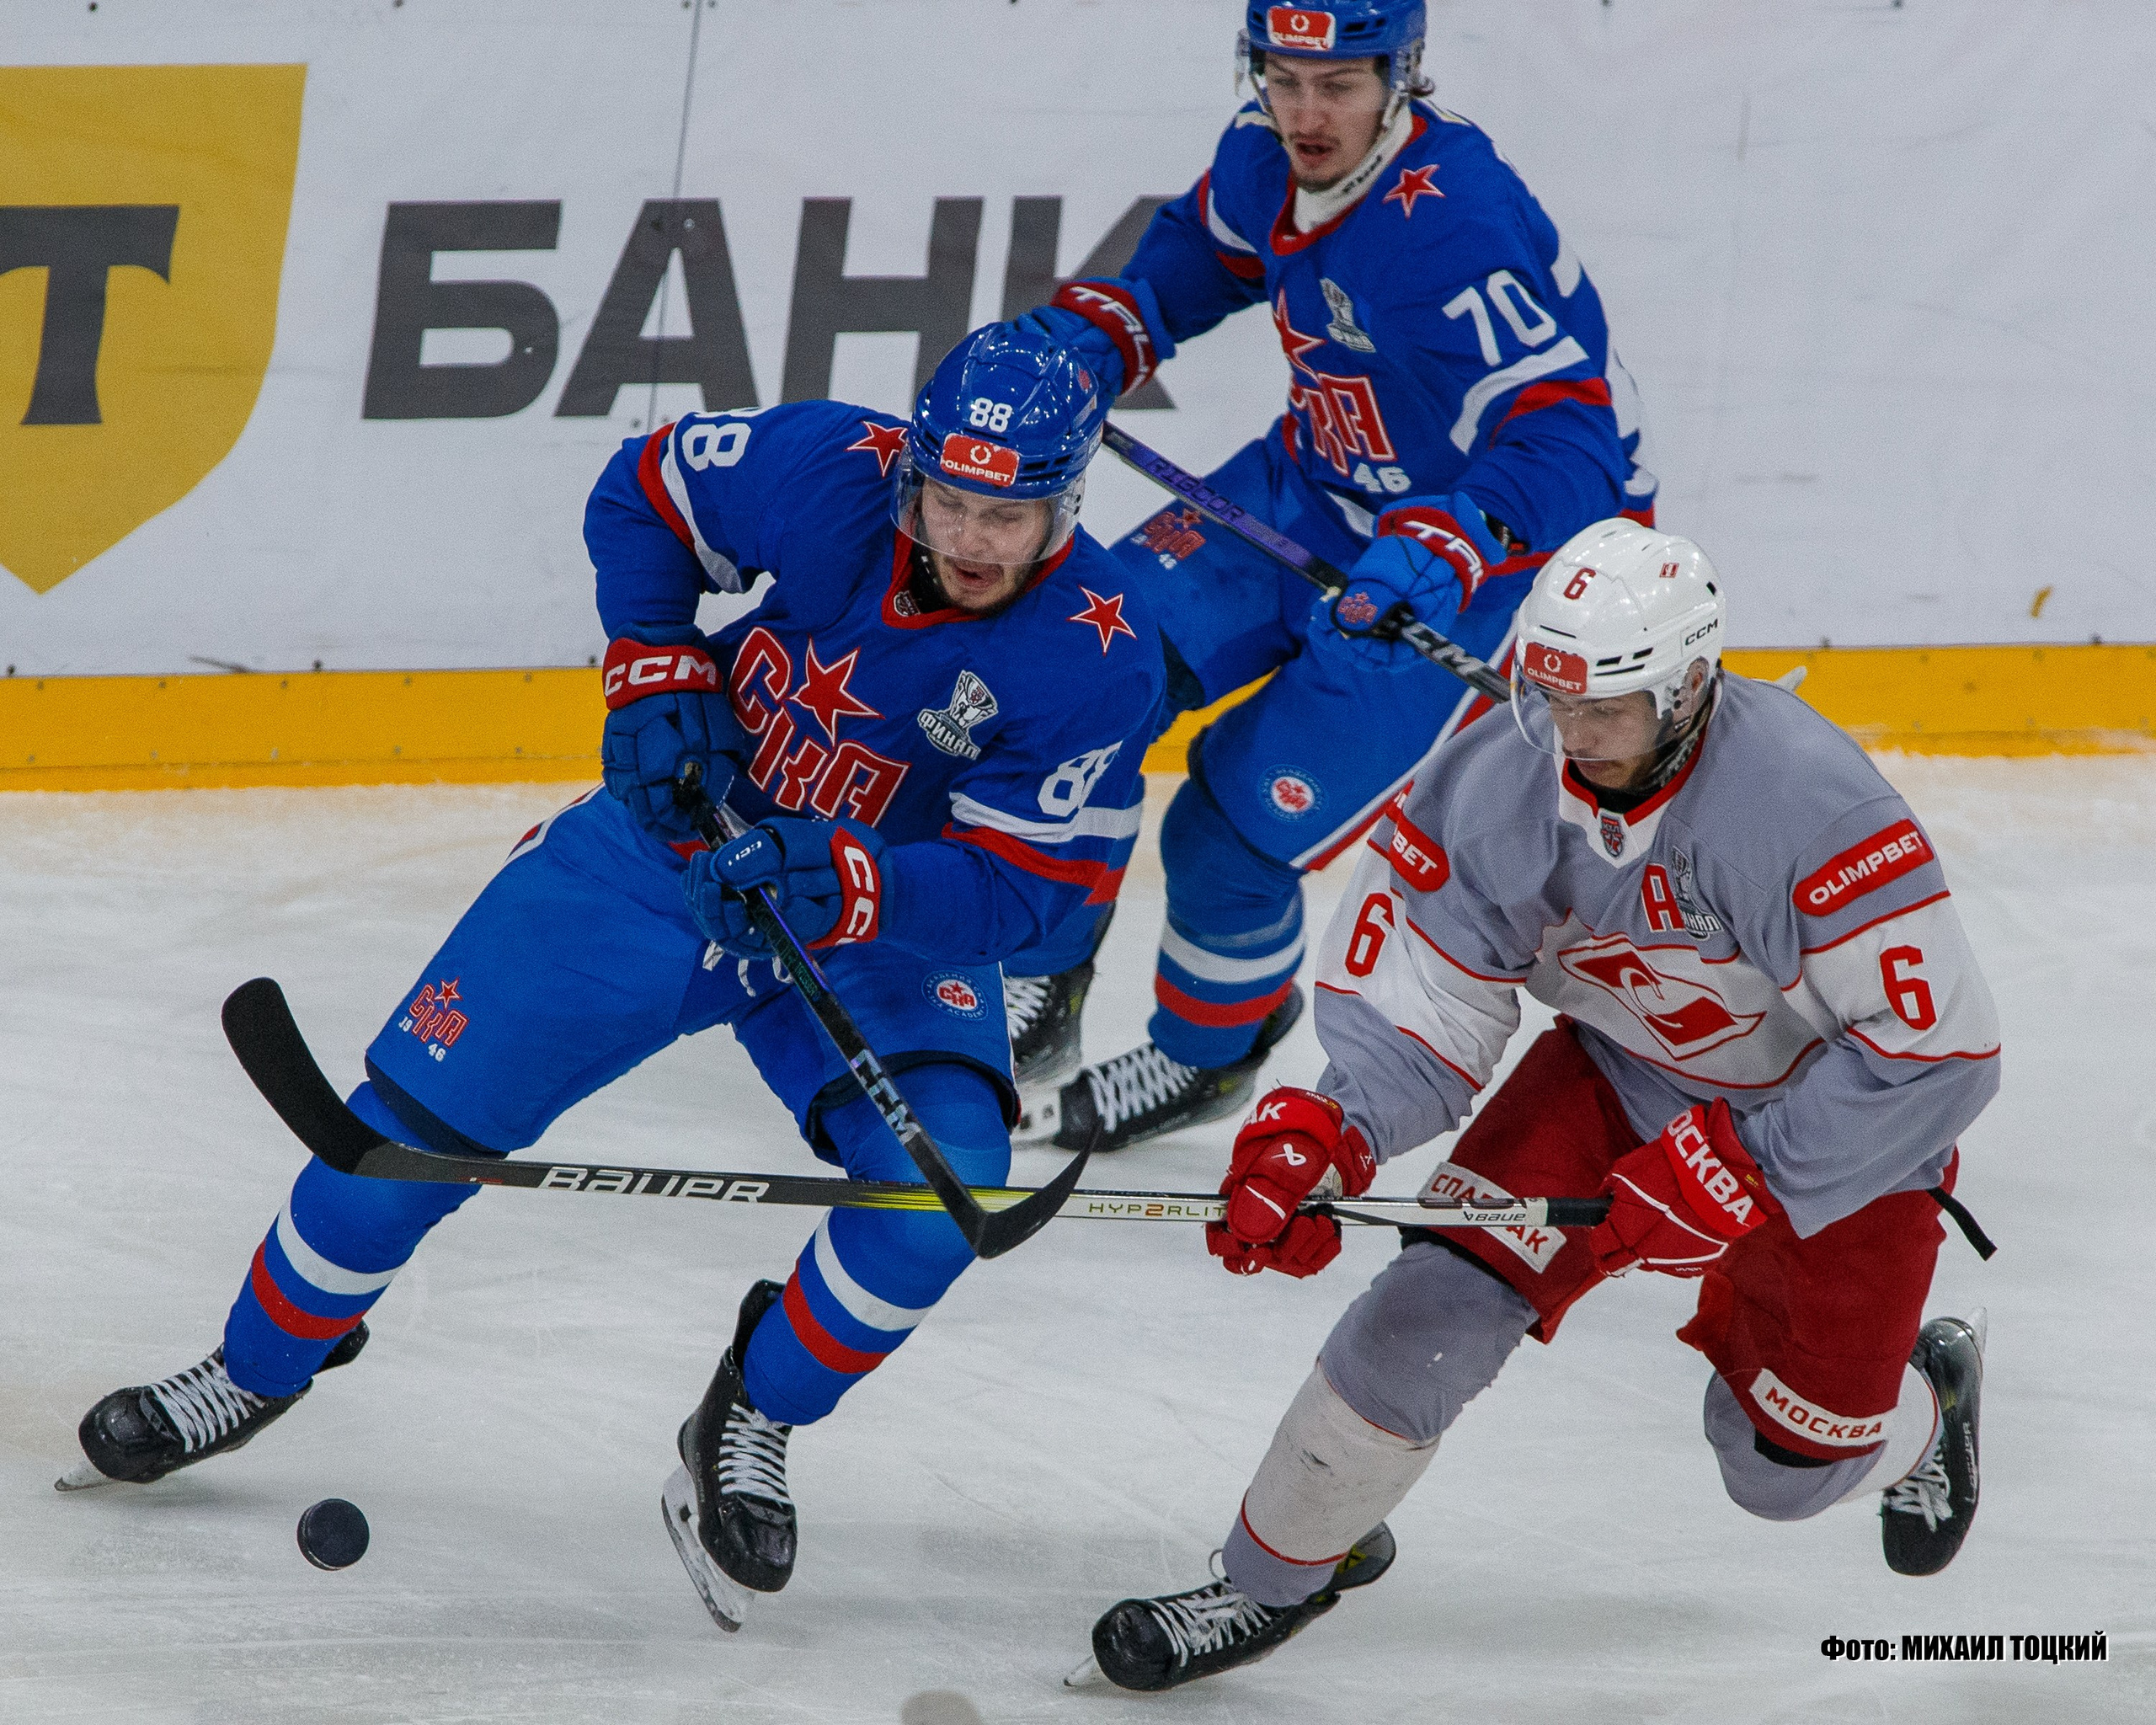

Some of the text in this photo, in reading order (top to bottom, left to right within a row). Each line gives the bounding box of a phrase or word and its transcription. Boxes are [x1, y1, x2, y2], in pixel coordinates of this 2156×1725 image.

[1442, 270, 1558, 368] 70
[1070, 286, 1150, 396] TRU
[969, 398, 1012, 433] 88
[1290, 372, 1398, 478] КА
[945, 459, 1010, 483] OLIMPBET
[1353, 462, 1411, 494] 46
[1563, 567, 1597, 601] 6
[1685, 617, 1719, 646] CCM
[604, 654, 717, 697] CCM
[1526, 667, 1582, 692] OLIMPBET
[727, 627, 913, 830] СКА
[920, 712, 978, 759] ФИНАЛ
[1809, 830, 1924, 905] OLIMPBET
[1344, 892, 1395, 978] 6
[939, 985, 975, 1007] СКА
[1879, 944, 1937, 1031] 6
[408, 983, 469, 1048] СКА
[428, 1044, 446, 1062] 46
[540, 1166, 770, 1203] BAUER
[1089, 1203, 1227, 1217] HYP2RLIT
[1431, 1173, 1550, 1255] СПААК
[1475, 1213, 1526, 1222] BAUE
[1765, 1386, 1882, 1439] МОСКВА
